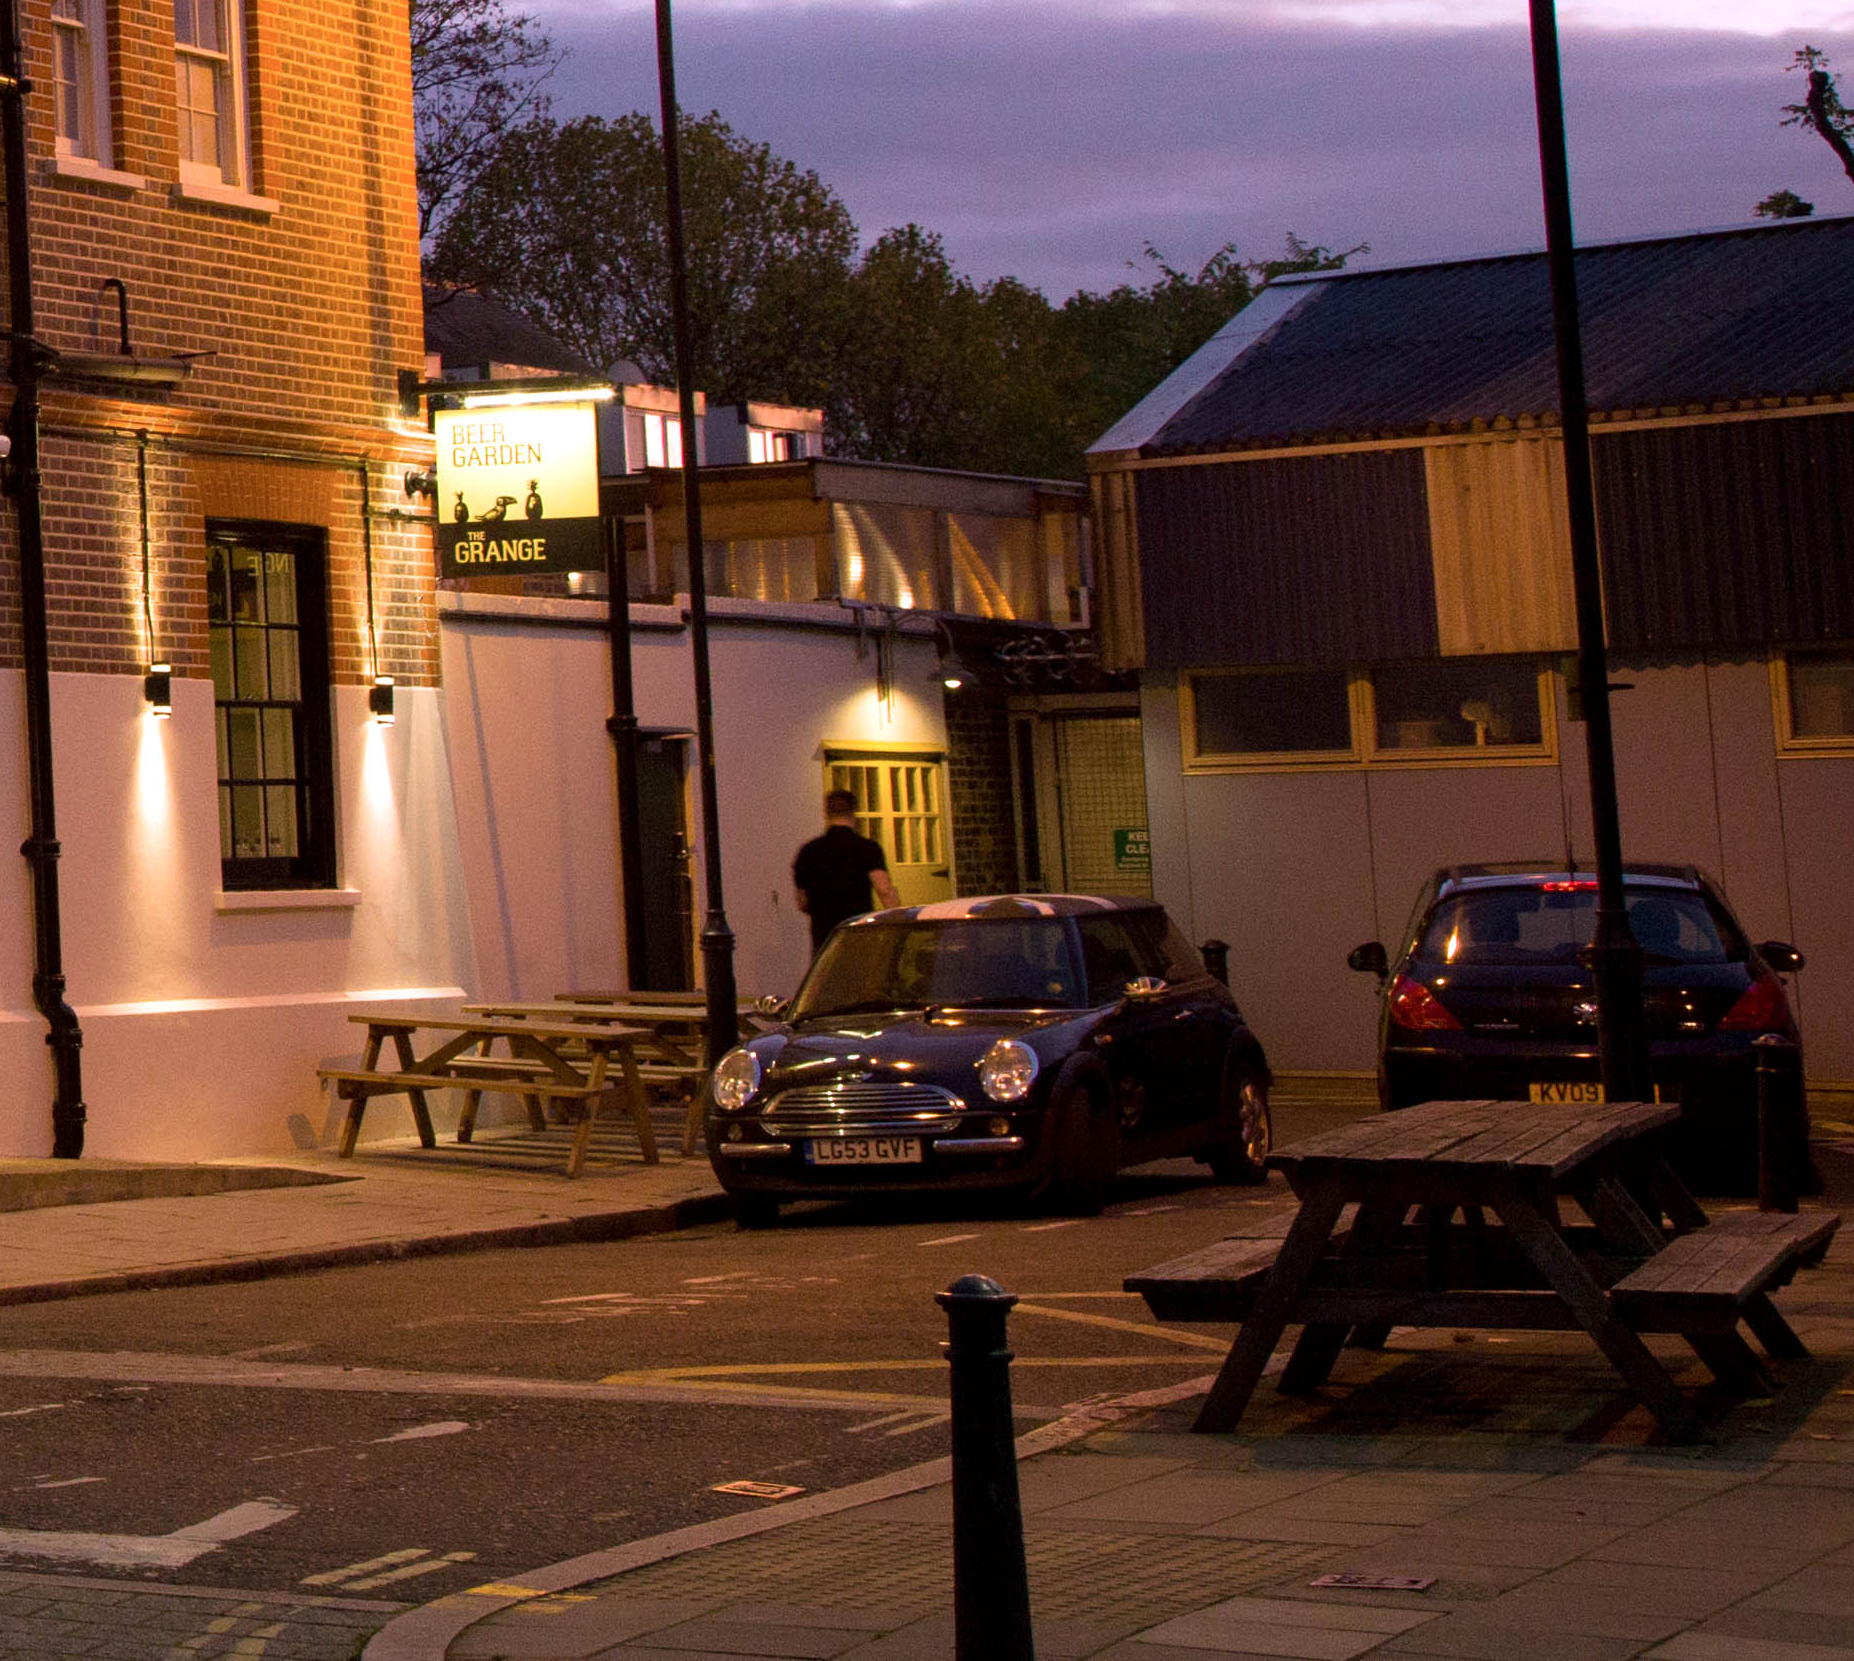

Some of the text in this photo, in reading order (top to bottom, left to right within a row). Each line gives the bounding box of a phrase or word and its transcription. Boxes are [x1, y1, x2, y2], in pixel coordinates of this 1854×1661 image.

[452, 423, 505, 445] BEER
[452, 443, 541, 468] GARDEN
[468, 531, 486, 541] THE
[455, 538, 546, 563] GRANGE
[1125, 843, 1149, 854] CLE
[1541, 1083, 1599, 1102] KV09
[817, 1139, 915, 1159] LG53 GVF
